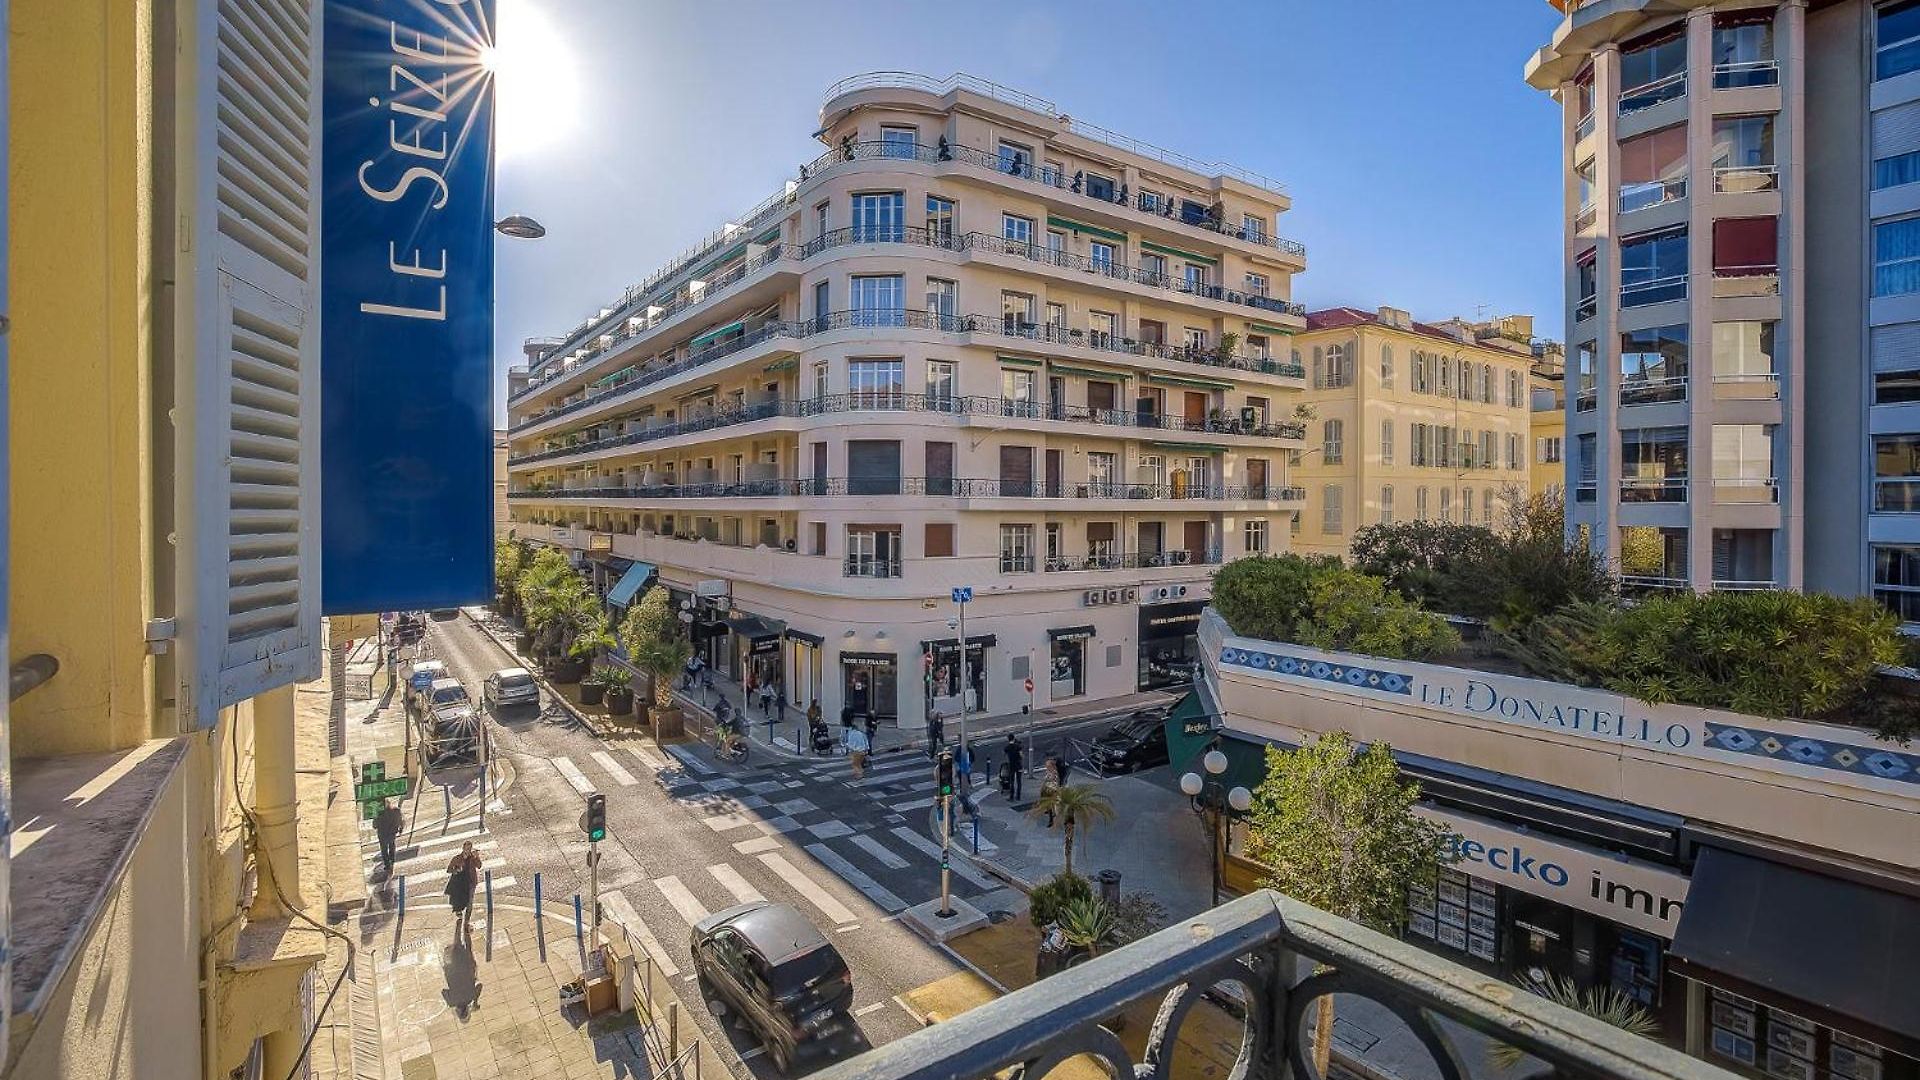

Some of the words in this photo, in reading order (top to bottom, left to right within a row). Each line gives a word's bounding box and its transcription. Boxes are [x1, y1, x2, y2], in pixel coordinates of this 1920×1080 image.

[360, 240, 447, 321] LE
[1421, 684, 1455, 708] LE
[1464, 680, 1691, 748] DONATELLO
